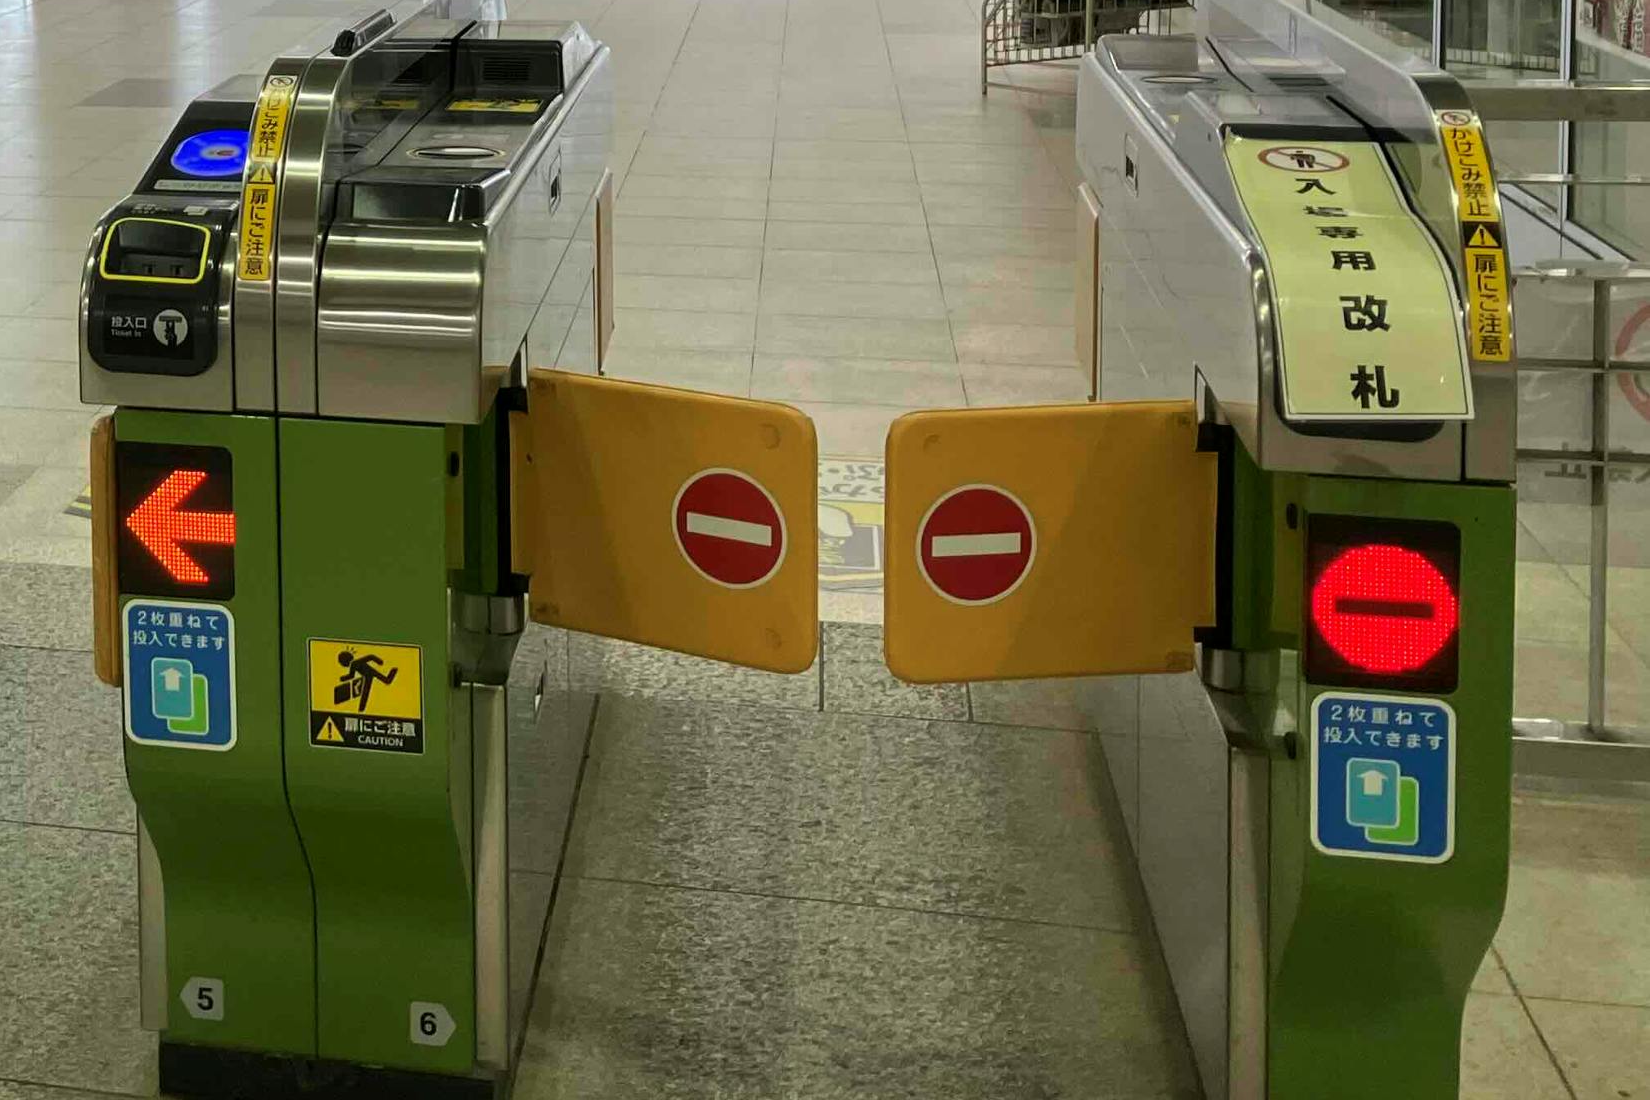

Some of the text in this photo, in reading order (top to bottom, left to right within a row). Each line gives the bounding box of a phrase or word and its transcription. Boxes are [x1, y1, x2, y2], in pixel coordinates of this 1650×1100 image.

[258, 89, 287, 157] けこみ禁止
[1451, 128, 1491, 216] かけこみ禁止
[245, 189, 269, 275] 扉にご注意
[1473, 254, 1503, 356] 扉にご注意
[111, 316, 147, 329] 投入口
[137, 609, 219, 630] 2枚重ねて
[133, 631, 225, 651] 投入できます
[344, 718, 417, 737] 扉にご注意
[1330, 704, 1437, 728] 2枚重ねて
[358, 735, 403, 747] CAUTION
[1324, 727, 1445, 750] 投入できます
[196, 987, 213, 1011] 5
[420, 1011, 436, 1035] 6
